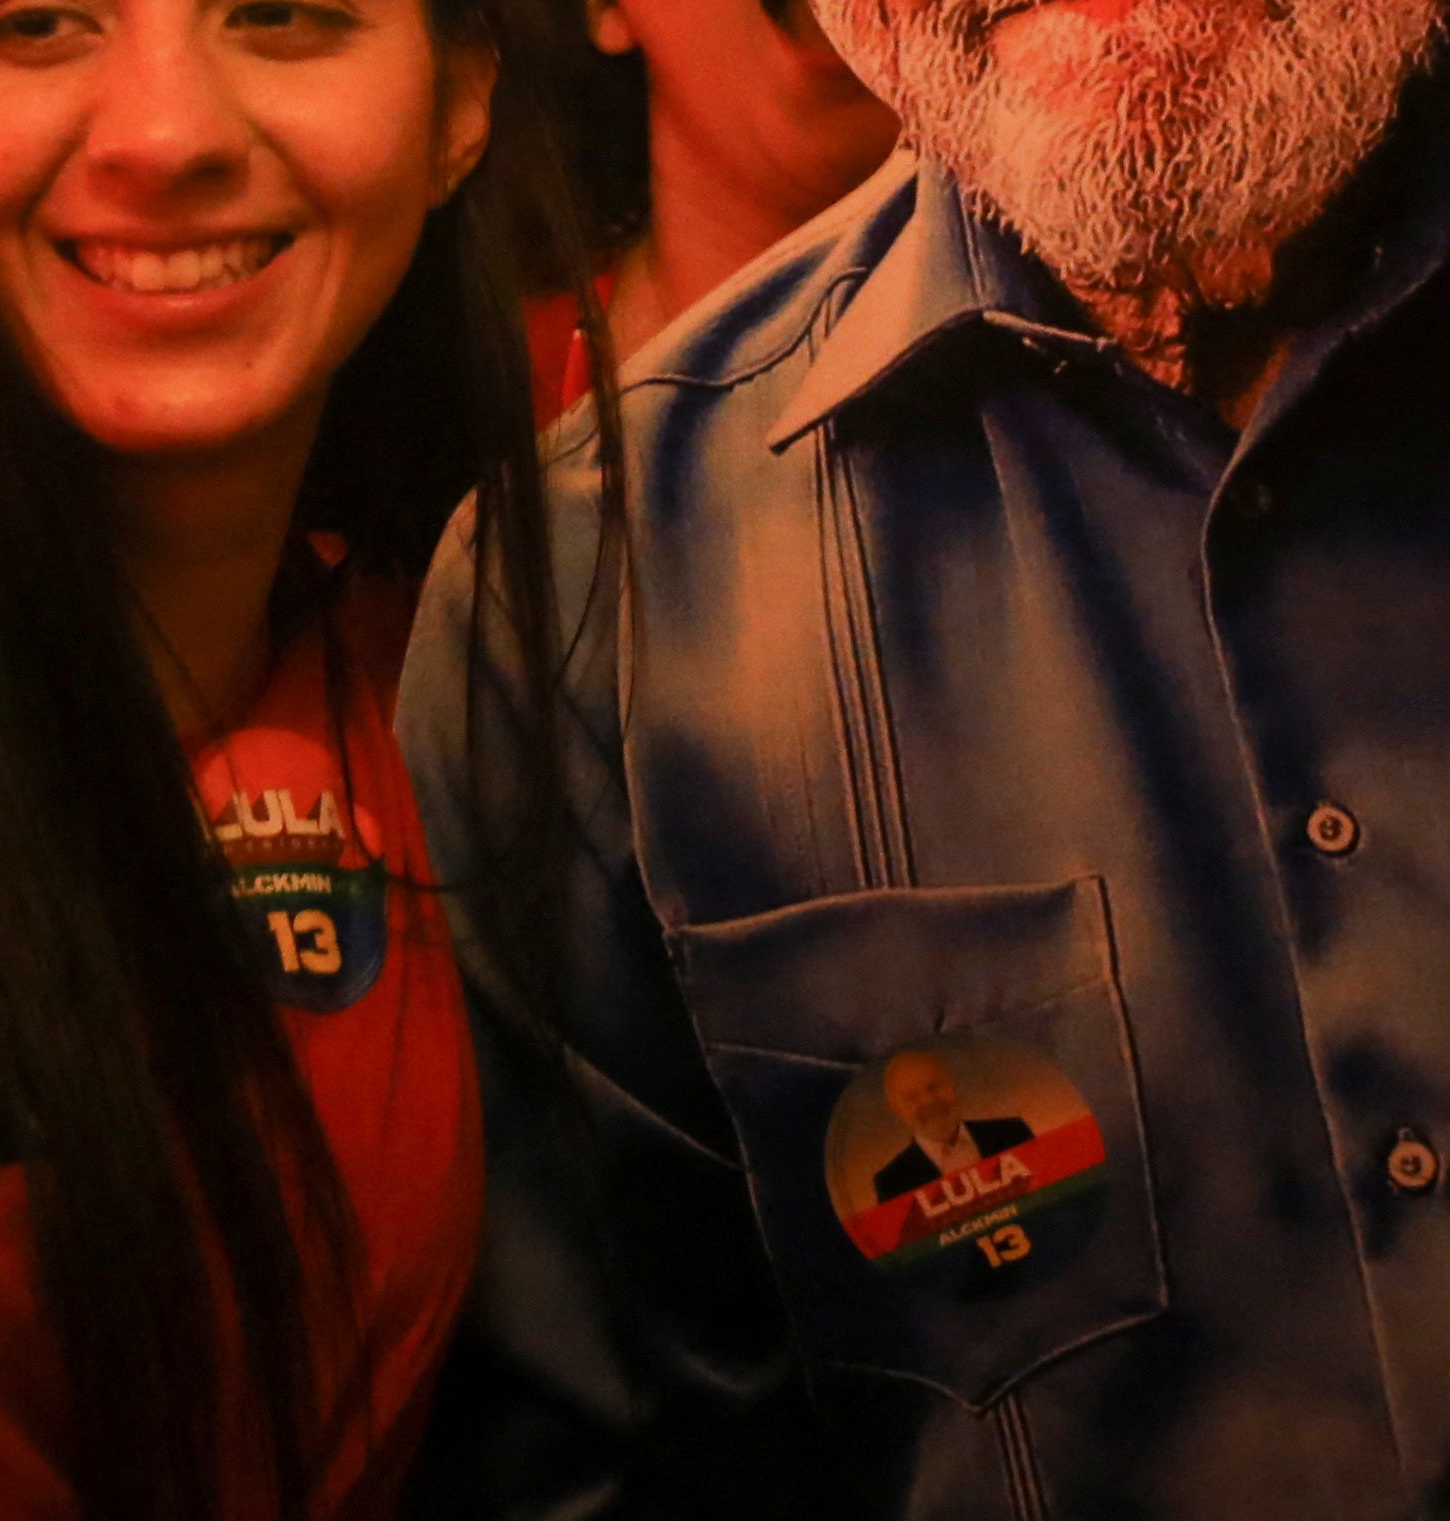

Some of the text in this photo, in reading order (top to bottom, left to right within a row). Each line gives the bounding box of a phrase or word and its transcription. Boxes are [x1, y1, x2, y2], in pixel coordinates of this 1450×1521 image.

[267, 909, 342, 975] 13
[914, 1152, 1031, 1218] LULA
[975, 1223, 1033, 1268] 13
